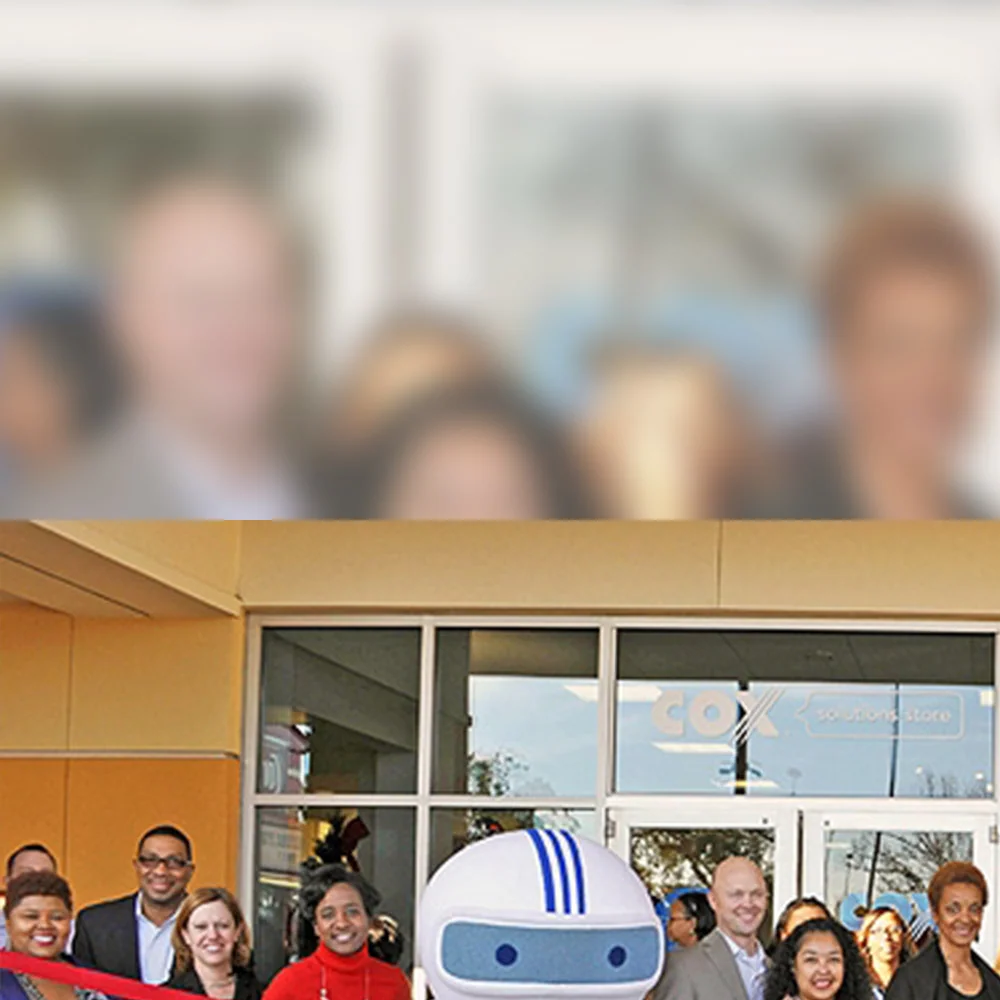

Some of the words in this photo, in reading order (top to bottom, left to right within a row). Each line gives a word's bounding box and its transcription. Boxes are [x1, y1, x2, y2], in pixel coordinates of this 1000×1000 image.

[652, 688, 786, 745] COX
[816, 703, 897, 723] soutions
[904, 704, 951, 723] store
